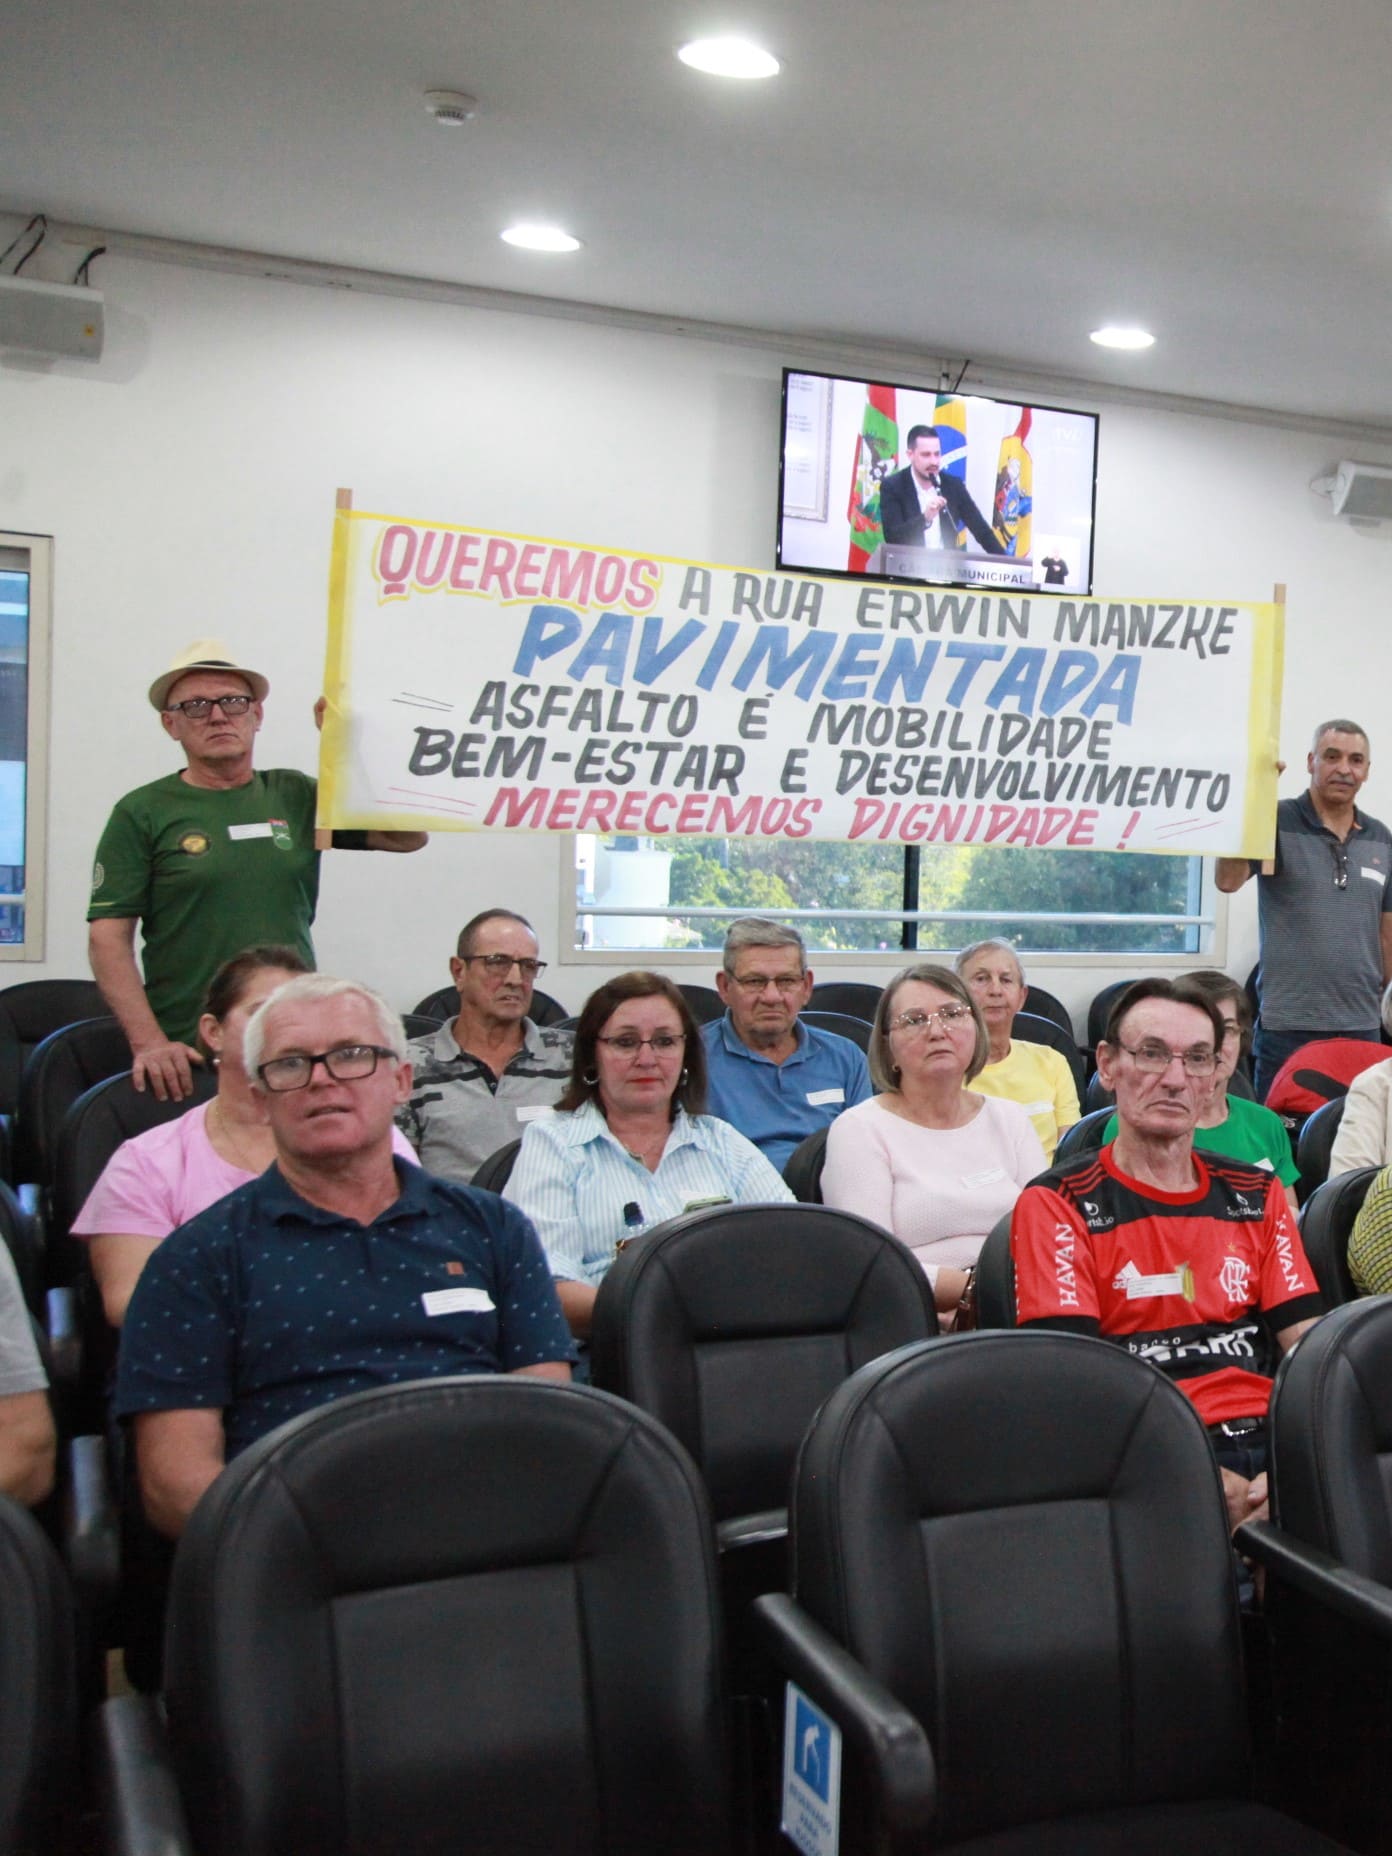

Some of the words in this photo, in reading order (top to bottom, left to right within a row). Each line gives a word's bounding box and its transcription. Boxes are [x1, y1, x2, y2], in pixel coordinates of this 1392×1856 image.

[378, 525, 659, 608] QUEREMOS
[679, 566, 711, 615] A
[732, 572, 824, 626] RUA
[856, 588, 1030, 638] ERWIN
[1054, 602, 1238, 659] MANZKE
[957, 568, 1025, 584] MUNICIPAL
[513, 605, 1142, 726] PAVIMENTADA
[469, 681, 698, 738] ASFALTO
[807, 703, 1113, 760] MOBILIDADE
[408, 726, 746, 796] BEM-ESTAR
[780, 748, 809, 793] E
[835, 749, 1231, 812] DESENVOLVIMENTO
[483, 786, 822, 838] MERECEMOS
[847, 797, 1099, 847] DIGNIDADE
[1055, 1223, 1079, 1307] HAVAN
